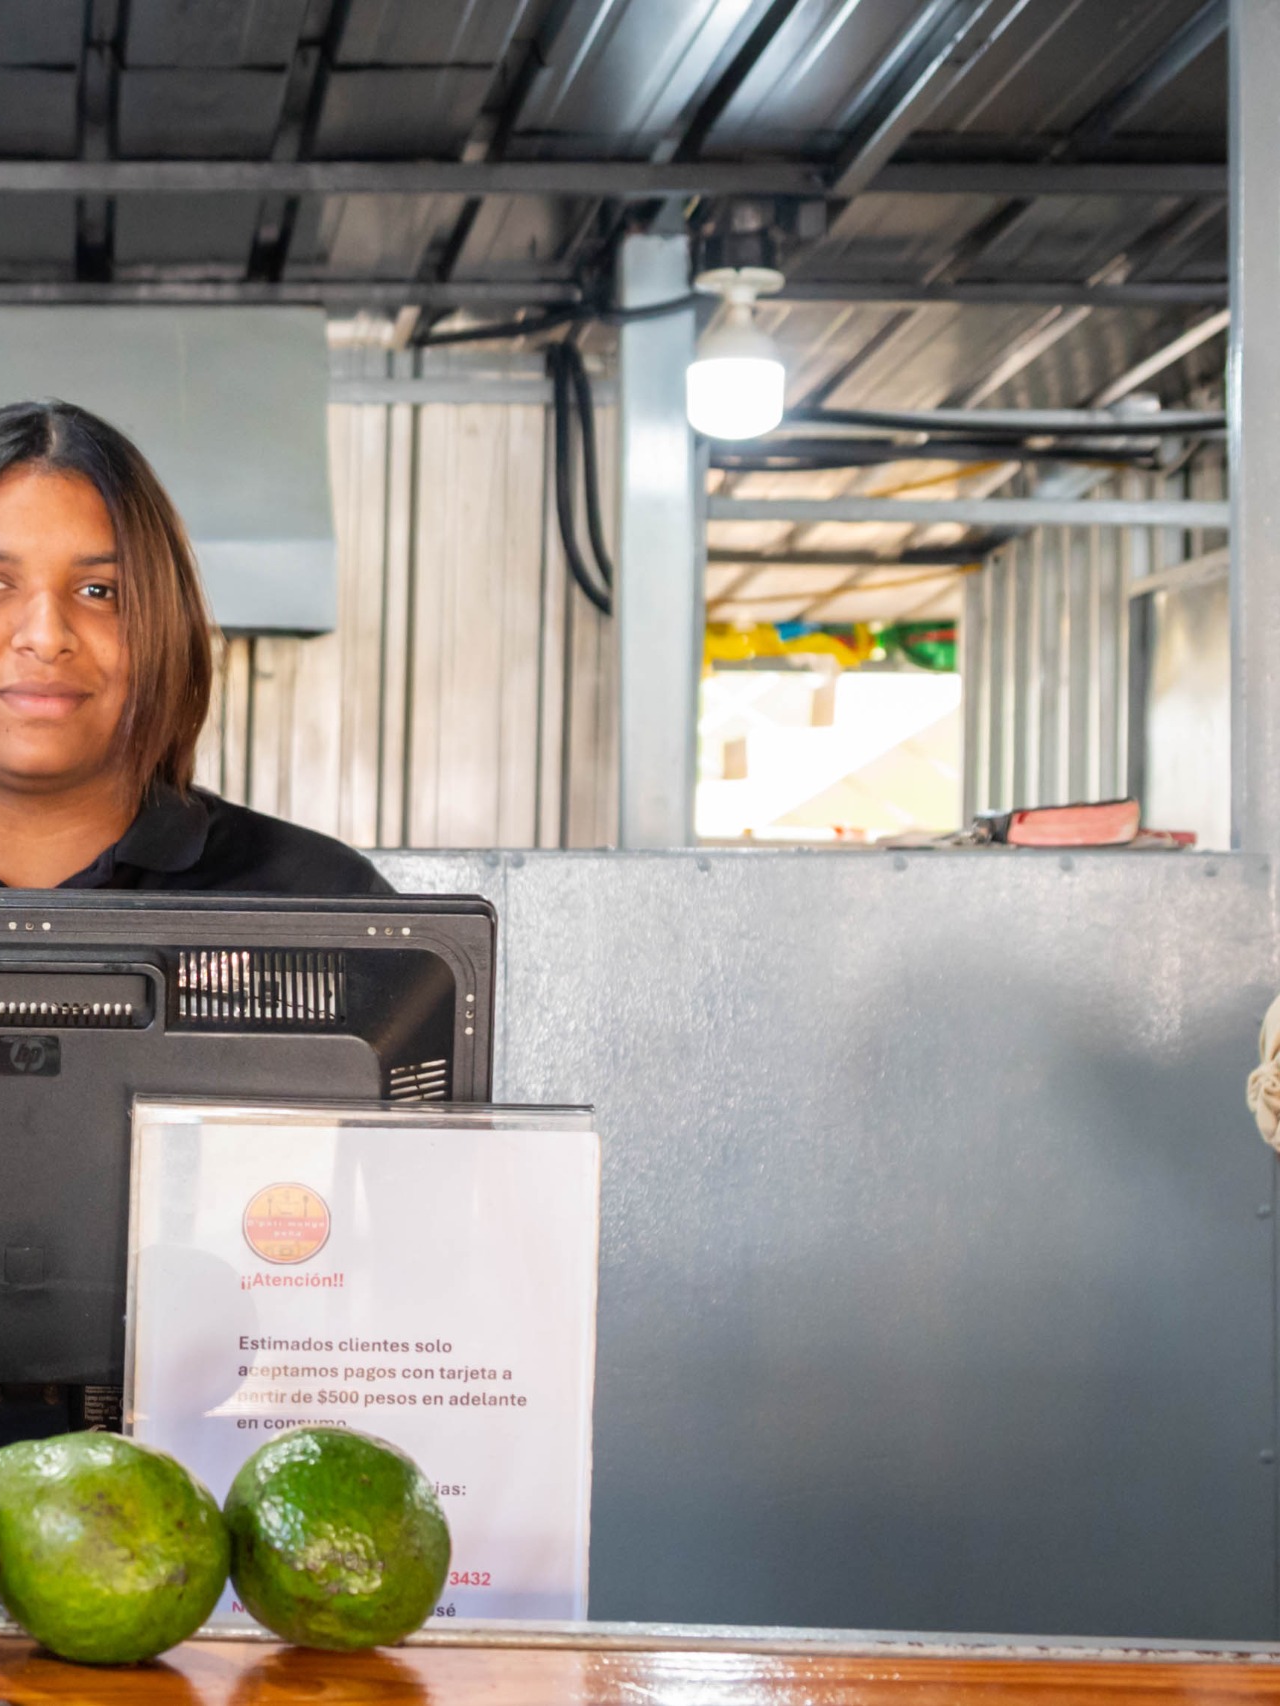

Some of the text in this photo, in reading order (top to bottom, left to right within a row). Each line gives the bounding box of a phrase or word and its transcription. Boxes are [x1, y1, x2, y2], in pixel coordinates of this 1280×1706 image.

[240, 1272, 345, 1290] ¡¡Atención!!
[238, 1336, 452, 1353] Estimados clientes solo
[238, 1364, 512, 1382] aceptamos pagos con tarjeta a
[291, 1390, 312, 1404] de
[317, 1389, 359, 1405] $500
[364, 1392, 417, 1407] pesos
[422, 1394, 443, 1406] en
[448, 1391, 527, 1407] adelante
[236, 1418, 258, 1429] en
[432, 1481, 467, 1496] ias:
[449, 1571, 491, 1586] 3432
